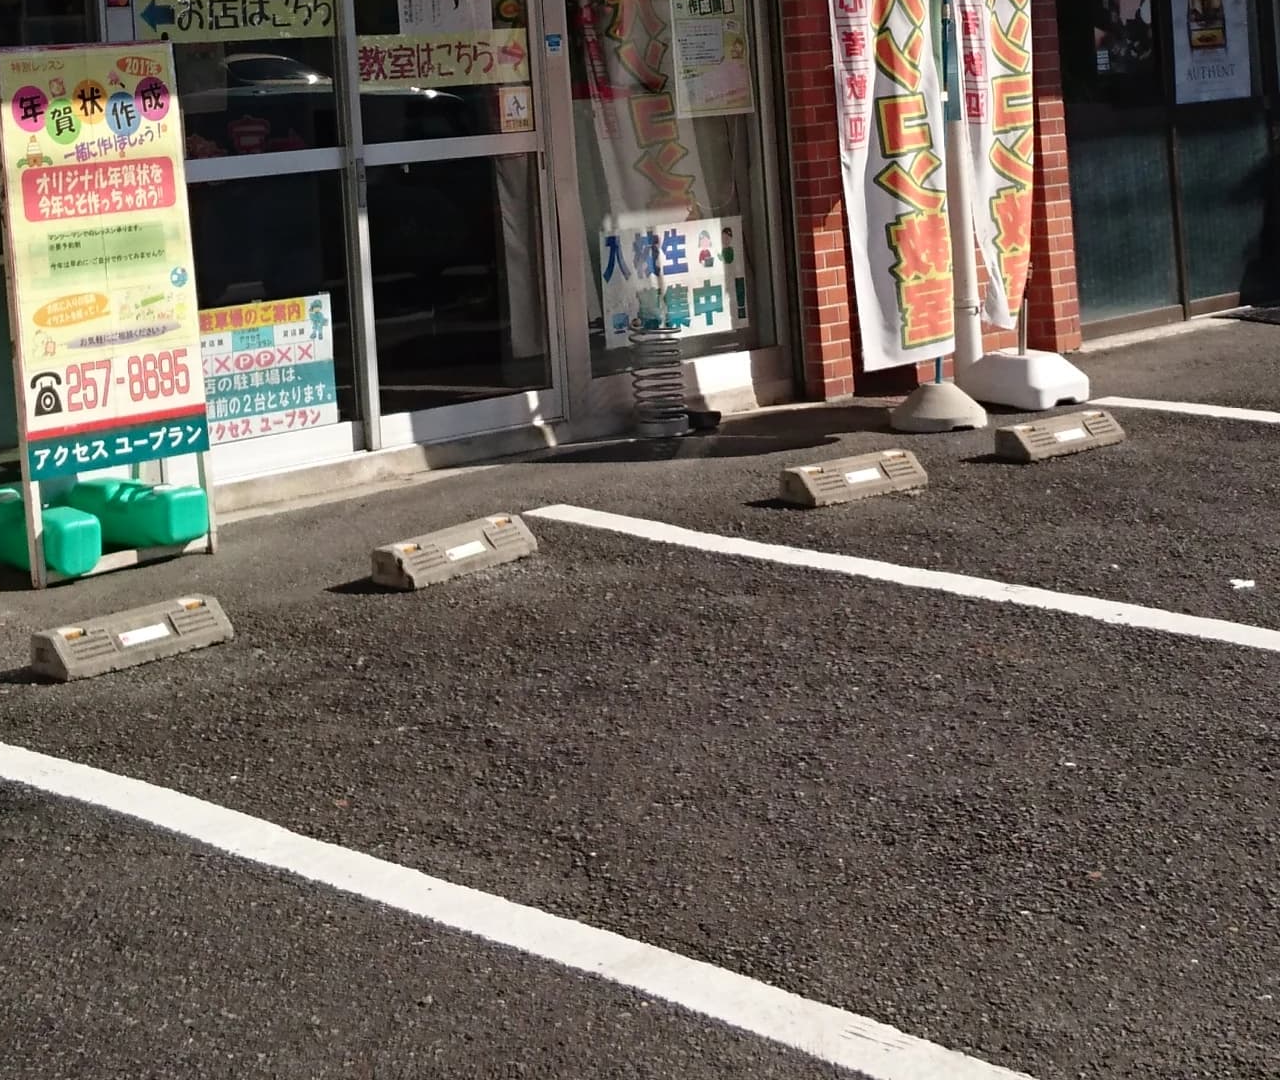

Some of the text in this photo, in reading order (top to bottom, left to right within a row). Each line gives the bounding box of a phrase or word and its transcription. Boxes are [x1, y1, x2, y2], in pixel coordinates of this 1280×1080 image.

[357, 40, 495, 82] 教室はこちら
[36, 163, 163, 195] オリジナル年賀状を
[65, 348, 191, 413] 257-8695
[259, 408, 321, 433] ユープラン
[33, 424, 202, 471] アクセス ユープラン
